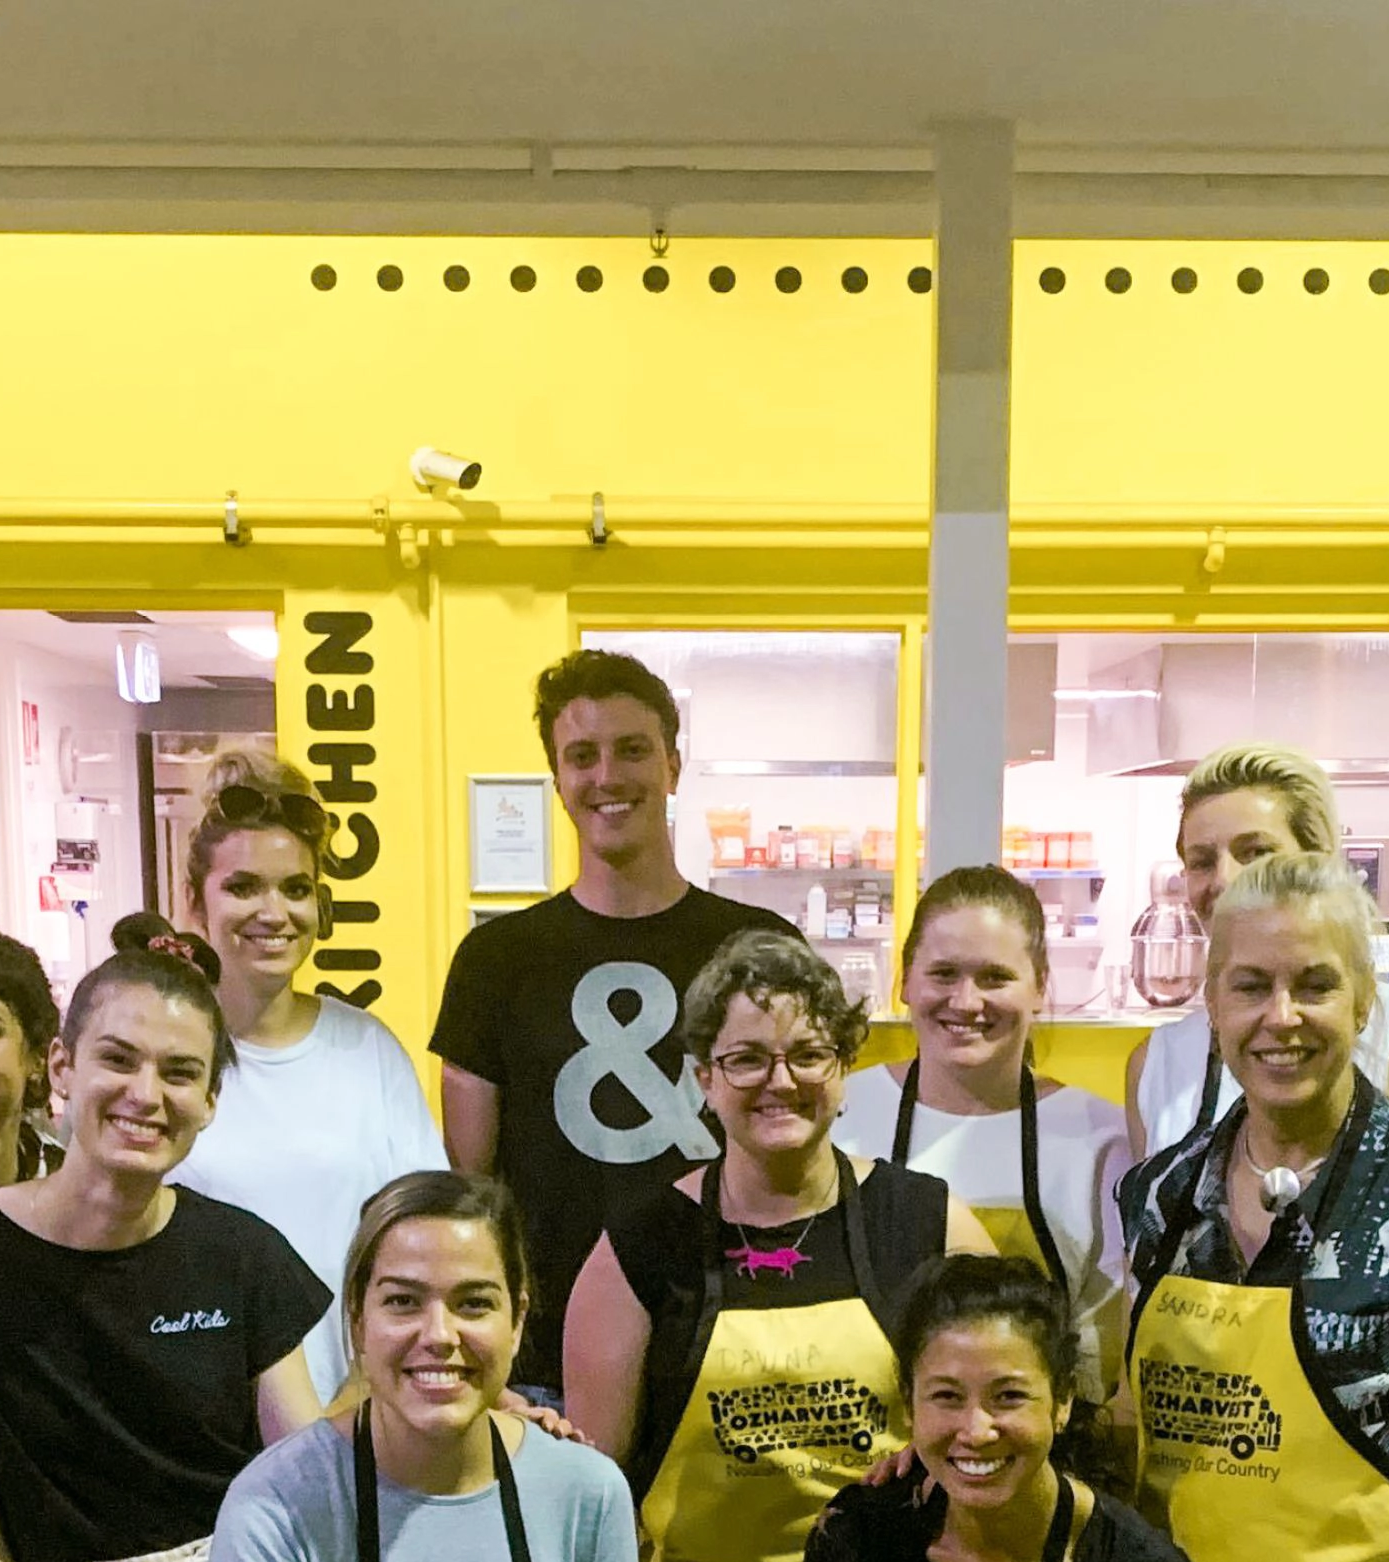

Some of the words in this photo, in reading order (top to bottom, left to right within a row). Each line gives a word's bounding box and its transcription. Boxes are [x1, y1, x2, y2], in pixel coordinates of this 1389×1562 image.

[150, 1311, 191, 1334] Cool
[191, 1308, 231, 1331] Kids
[1155, 1291, 1242, 1328] SANDRA
[730, 1400, 864, 1431] OZHARVEST
[1216, 1457, 1280, 1484] Country
